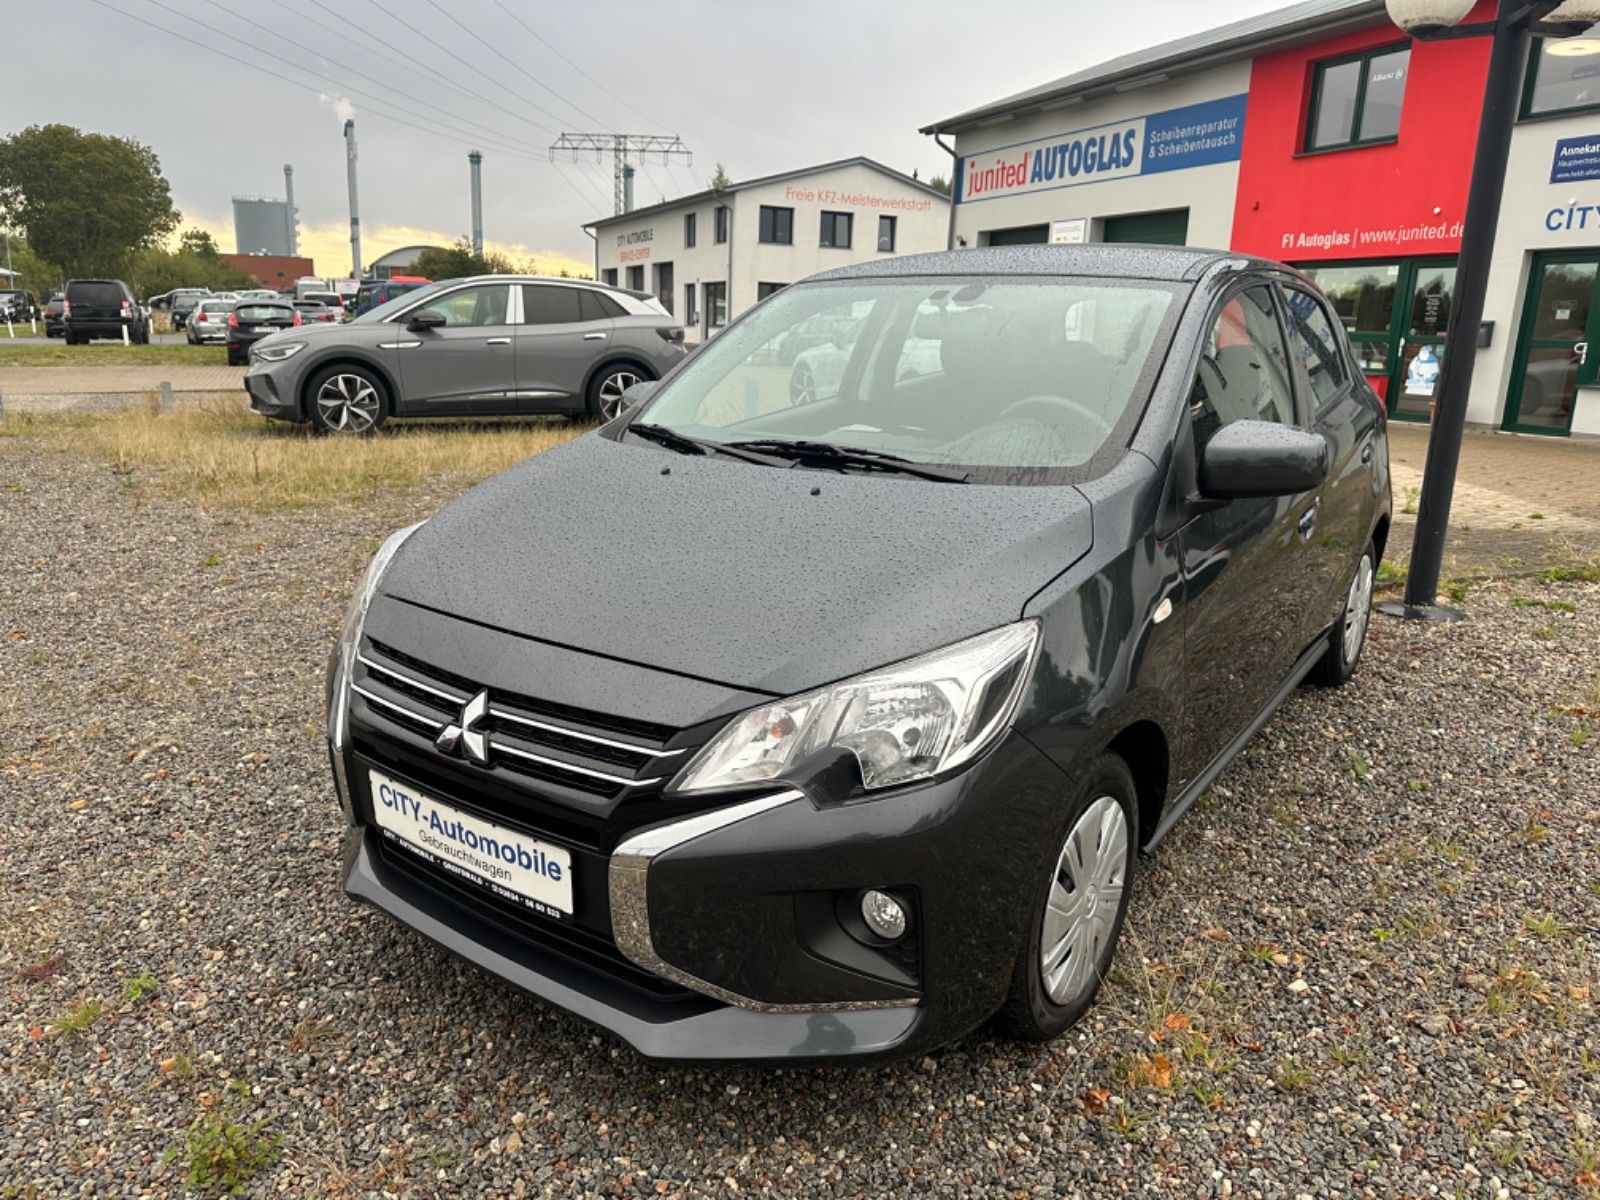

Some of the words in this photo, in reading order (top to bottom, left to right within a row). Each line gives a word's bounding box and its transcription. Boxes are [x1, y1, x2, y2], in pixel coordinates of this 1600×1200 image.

[1148, 146, 1156, 159] &
[1158, 131, 1236, 157] Scheibentausch
[1150, 118, 1238, 144] Scheibenreparatur
[967, 151, 1028, 197] junited
[1030, 128, 1136, 183] AUTOGLAS
[785, 187, 815, 201] Freie
[818, 190, 931, 211] KFZ-Meisterwerkstatt
[1281, 233, 1295, 249] F1
[1297, 230, 1351, 250] Autoglas
[379, 783, 562, 882] CITY-Automobile
[418, 829, 512, 882] Gebrauchtwagen
